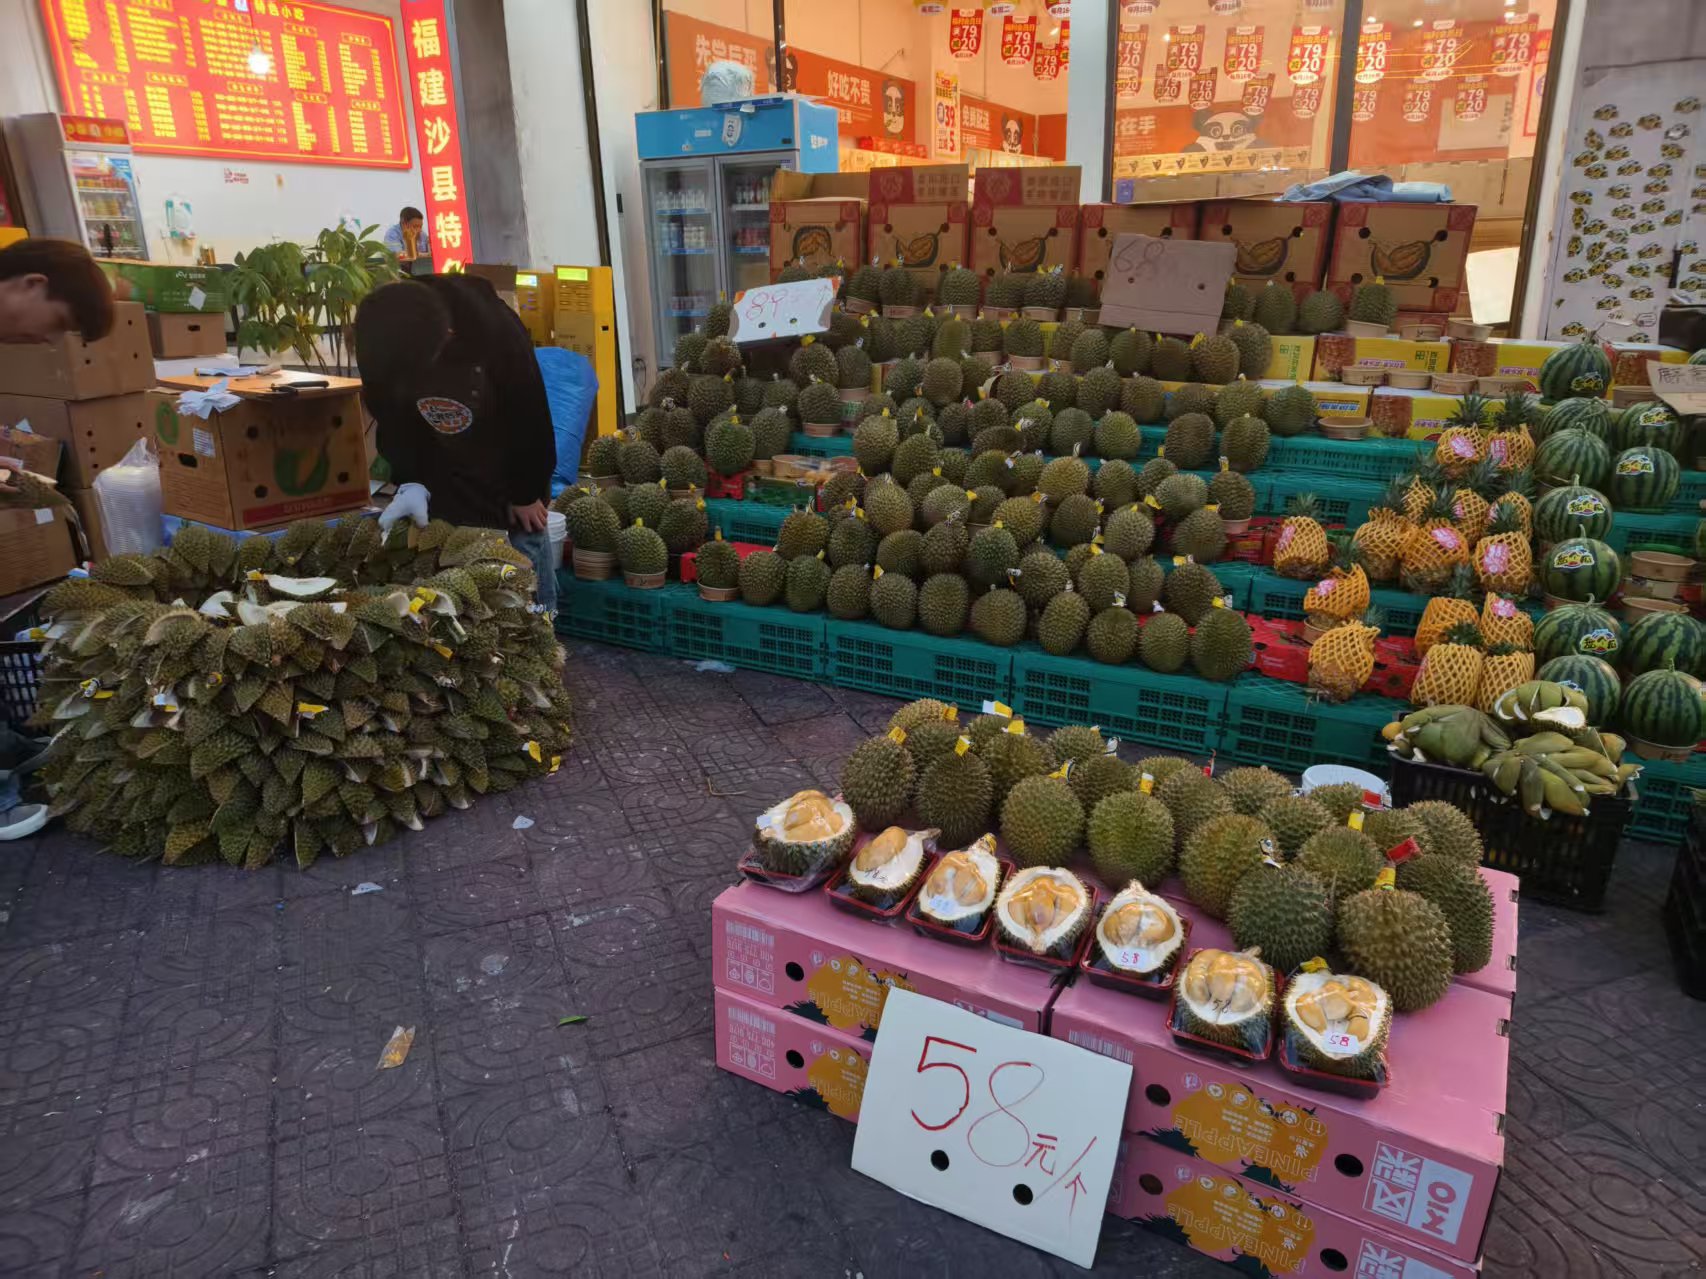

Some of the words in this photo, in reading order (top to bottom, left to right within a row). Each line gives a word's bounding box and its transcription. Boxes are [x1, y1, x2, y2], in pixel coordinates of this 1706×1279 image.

[827, 70, 871, 104] 好吃不贵
[1116, 116, 1156, 136] 在手
[1121, 951, 1140, 964] 58
[1330, 1034, 1350, 1047] 58
[1172, 1111, 1320, 1183] PINEAPPLE
[1422, 1180, 1457, 1236] MIO
[1166, 1201, 1308, 1275] PINEAPPLE
